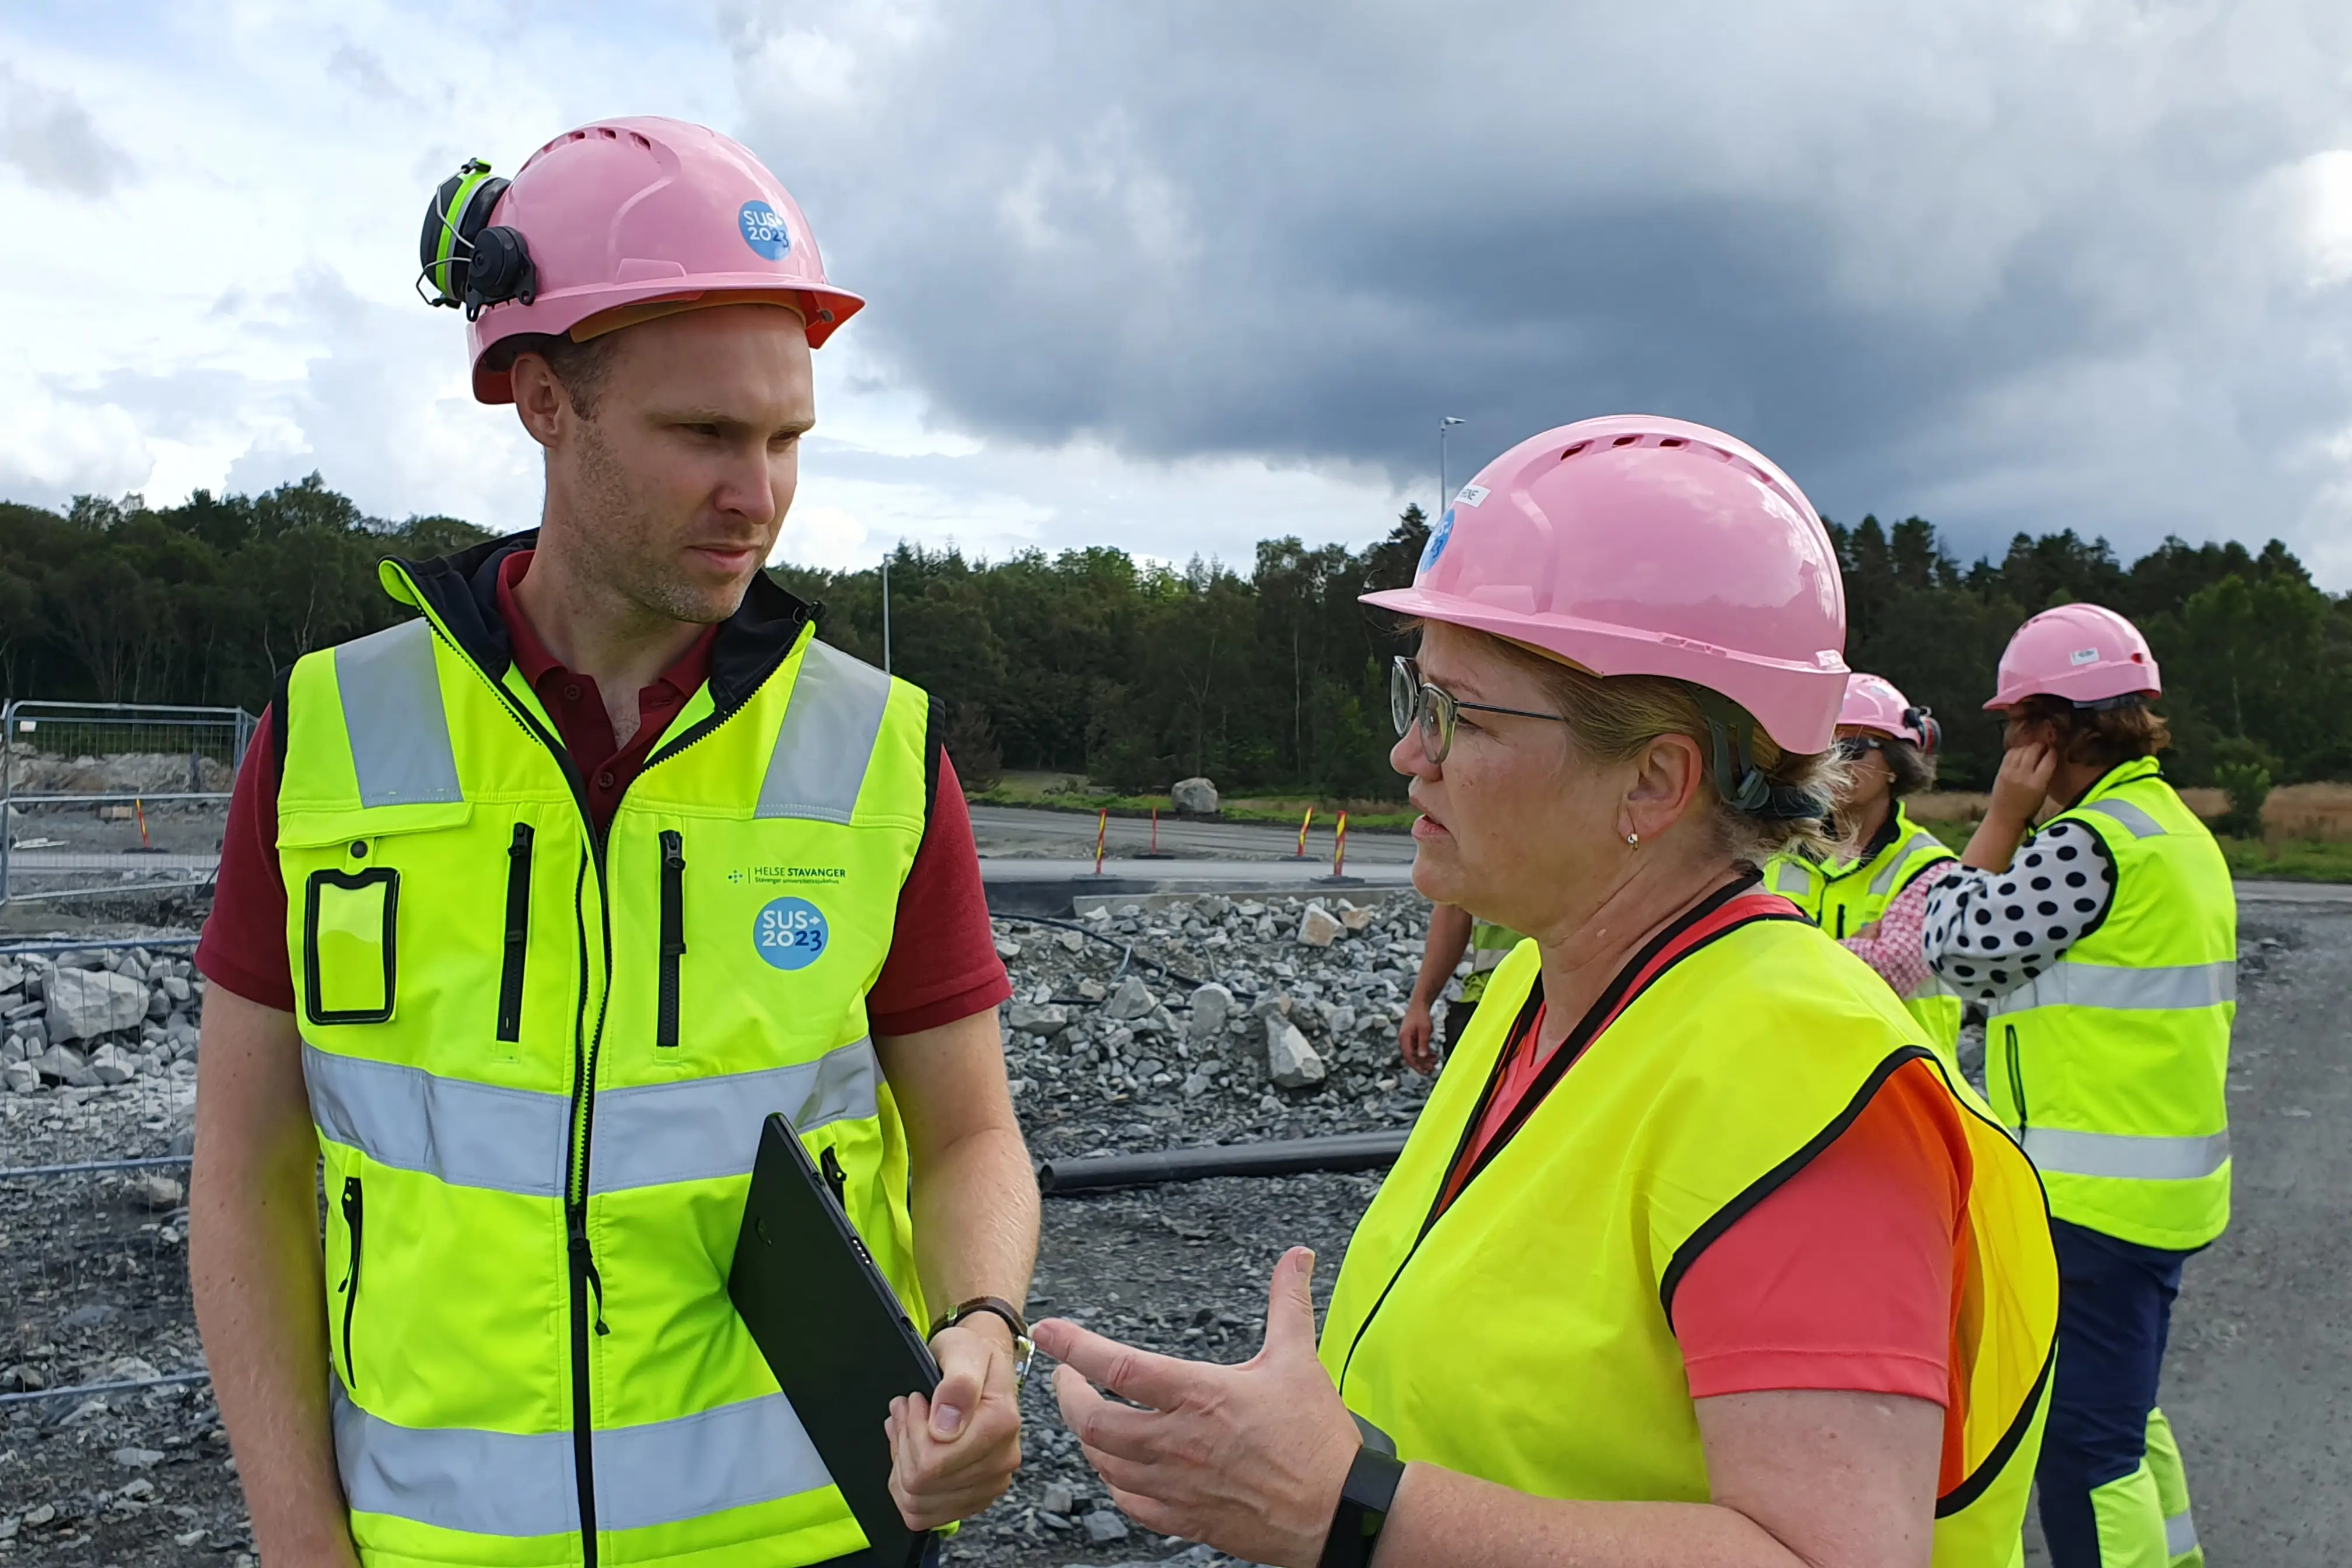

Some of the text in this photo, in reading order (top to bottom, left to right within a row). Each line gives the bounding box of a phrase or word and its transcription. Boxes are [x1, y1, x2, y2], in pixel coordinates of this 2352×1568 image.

[743, 211, 776, 227] SUS
[747, 226, 789, 248] 2023
[754, 866, 846, 878] HELSE STAVANGER
[762, 910, 808, 929] SUS
[762, 930, 822, 952] 2023
